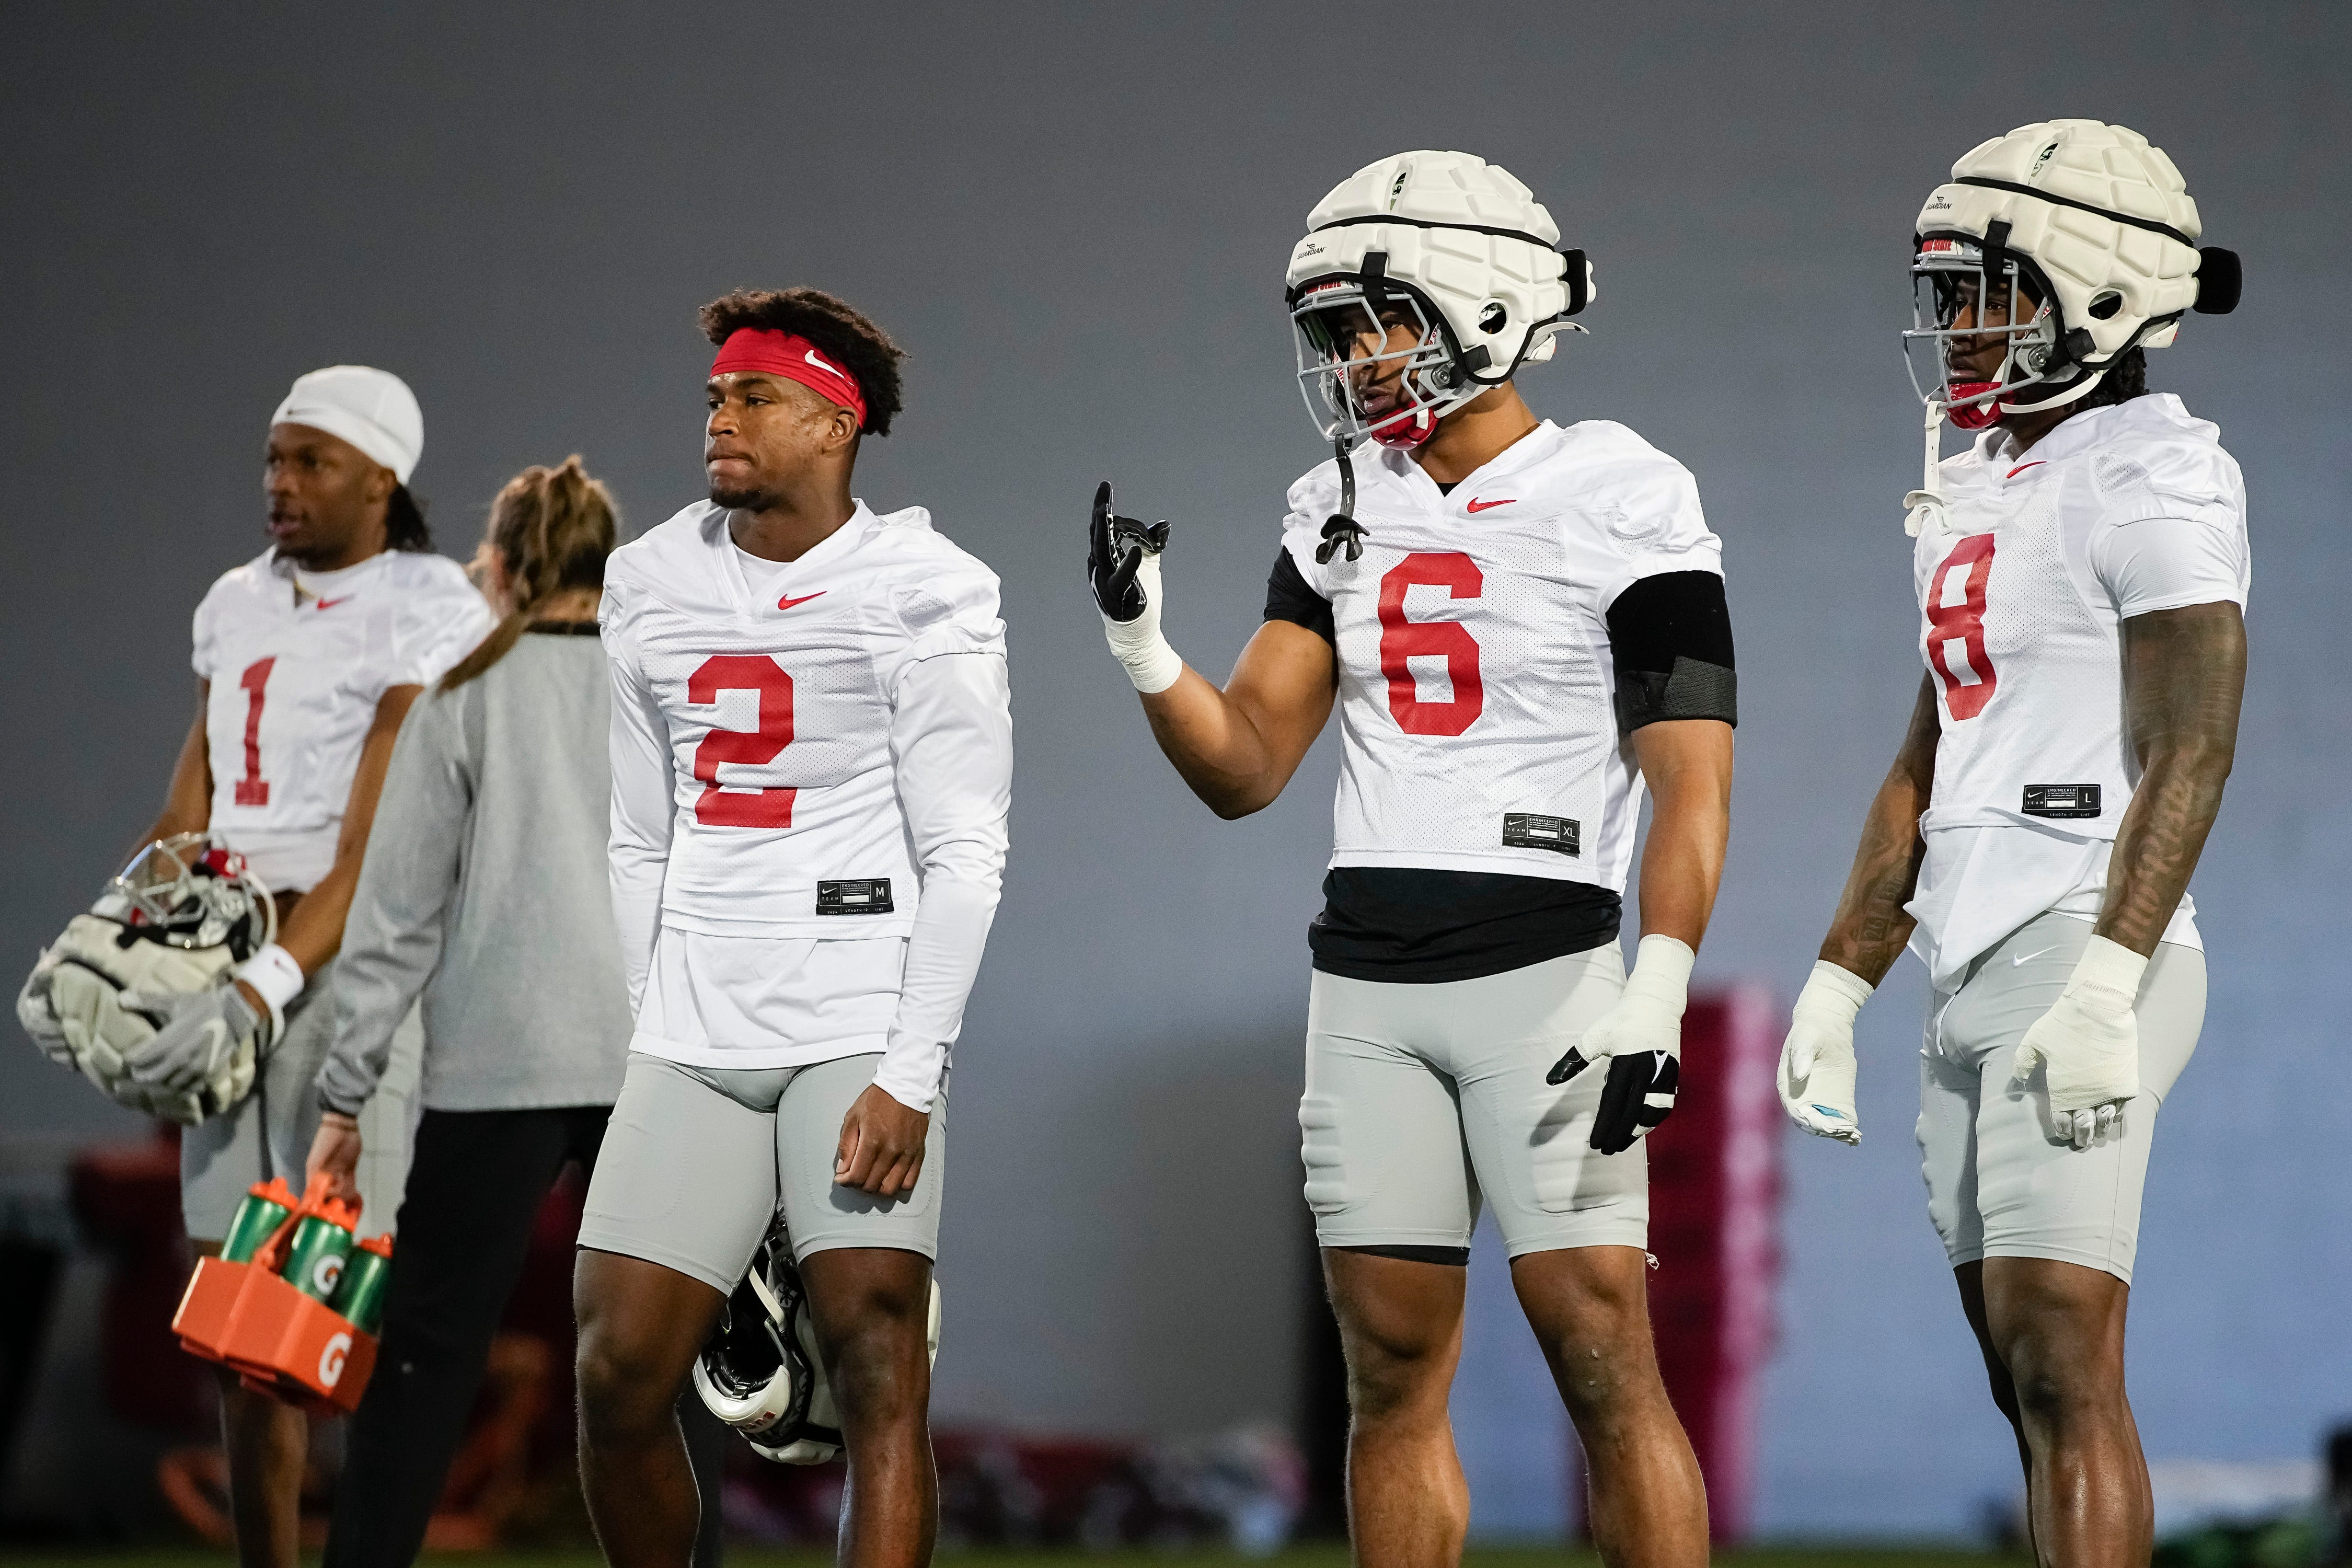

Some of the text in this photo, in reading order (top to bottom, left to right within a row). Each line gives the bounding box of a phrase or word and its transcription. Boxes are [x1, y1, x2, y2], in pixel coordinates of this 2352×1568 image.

[1297, 247, 1325, 260] GUARDIAN
[1378, 552, 1483, 736] 6
[1927, 533, 1997, 721] 8
[235, 655, 277, 805] 1
[687, 655, 794, 828] 2
[2085, 793, 2091, 803] L
[1563, 826, 1575, 838] XL
[876, 887, 884, 897] M
[314, 1255, 344, 1296] G
[319, 1332, 352, 1387] G
